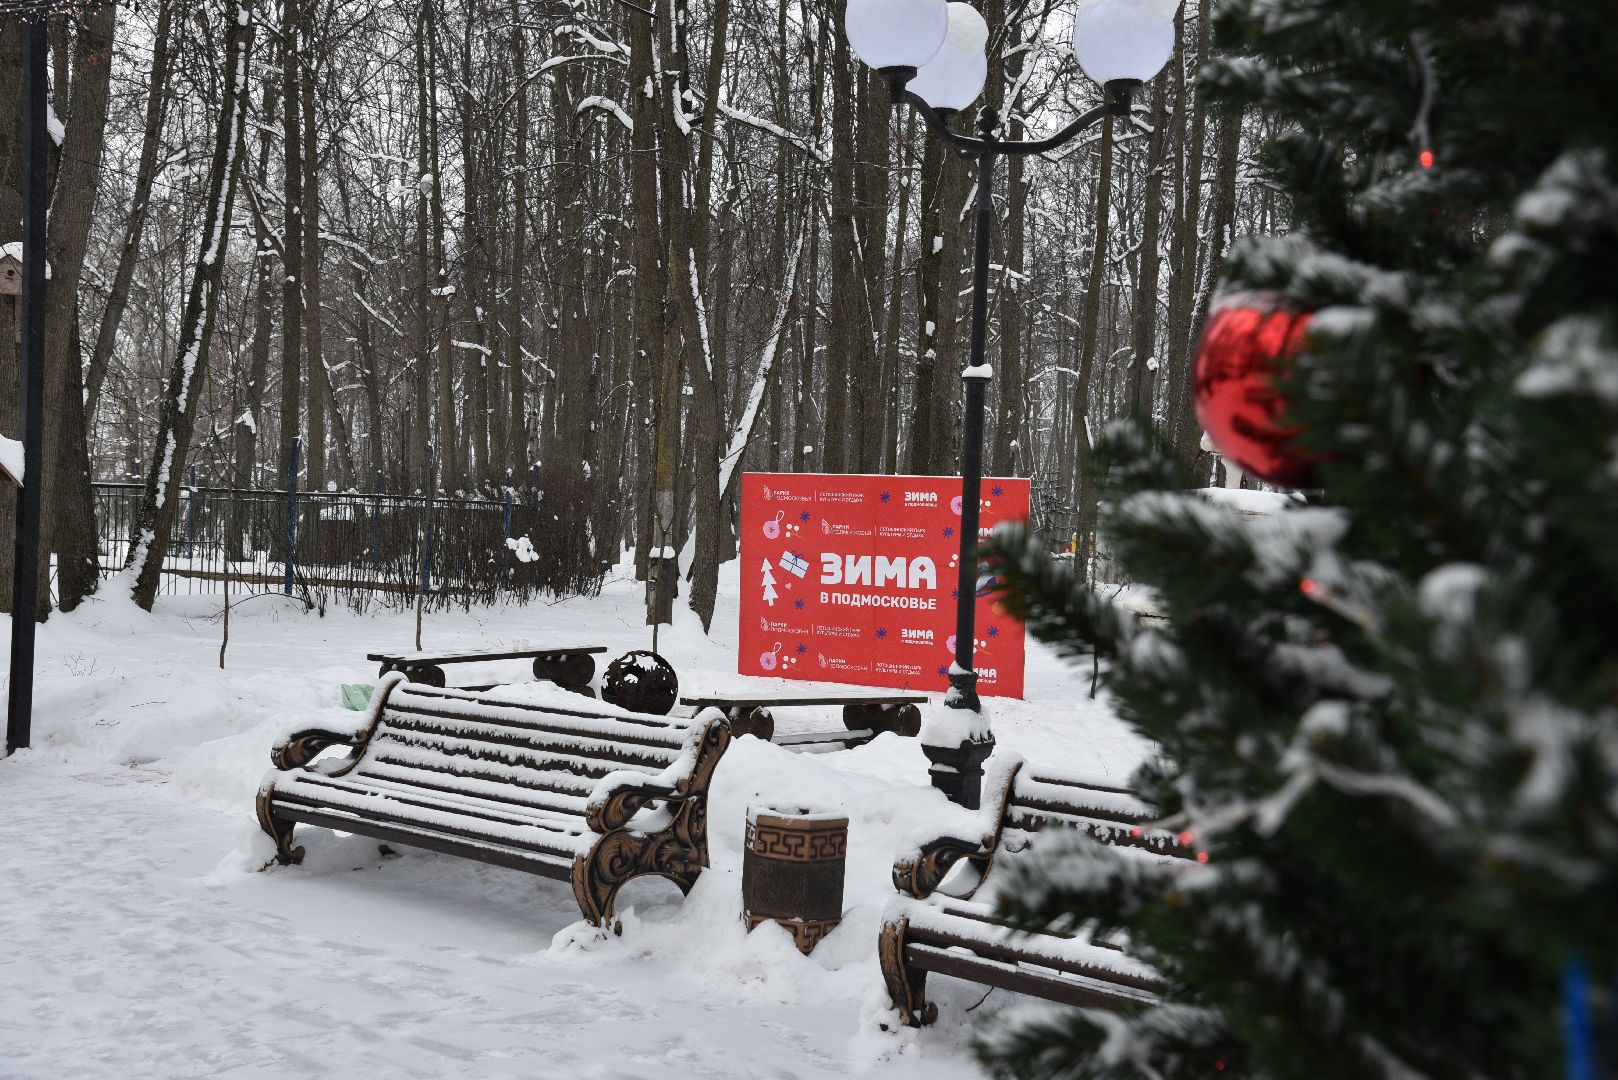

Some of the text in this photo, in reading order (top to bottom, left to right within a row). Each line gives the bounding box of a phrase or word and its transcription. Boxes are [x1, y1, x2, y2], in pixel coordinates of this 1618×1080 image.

[905, 492, 937, 502] ЗИМА
[820, 552, 936, 590] ЗИМА
[820, 592, 936, 610] В ПОДМОСКОВЬЕ
[902, 628, 934, 640] ЗИМА
[973, 668, 996, 678] ИМА
